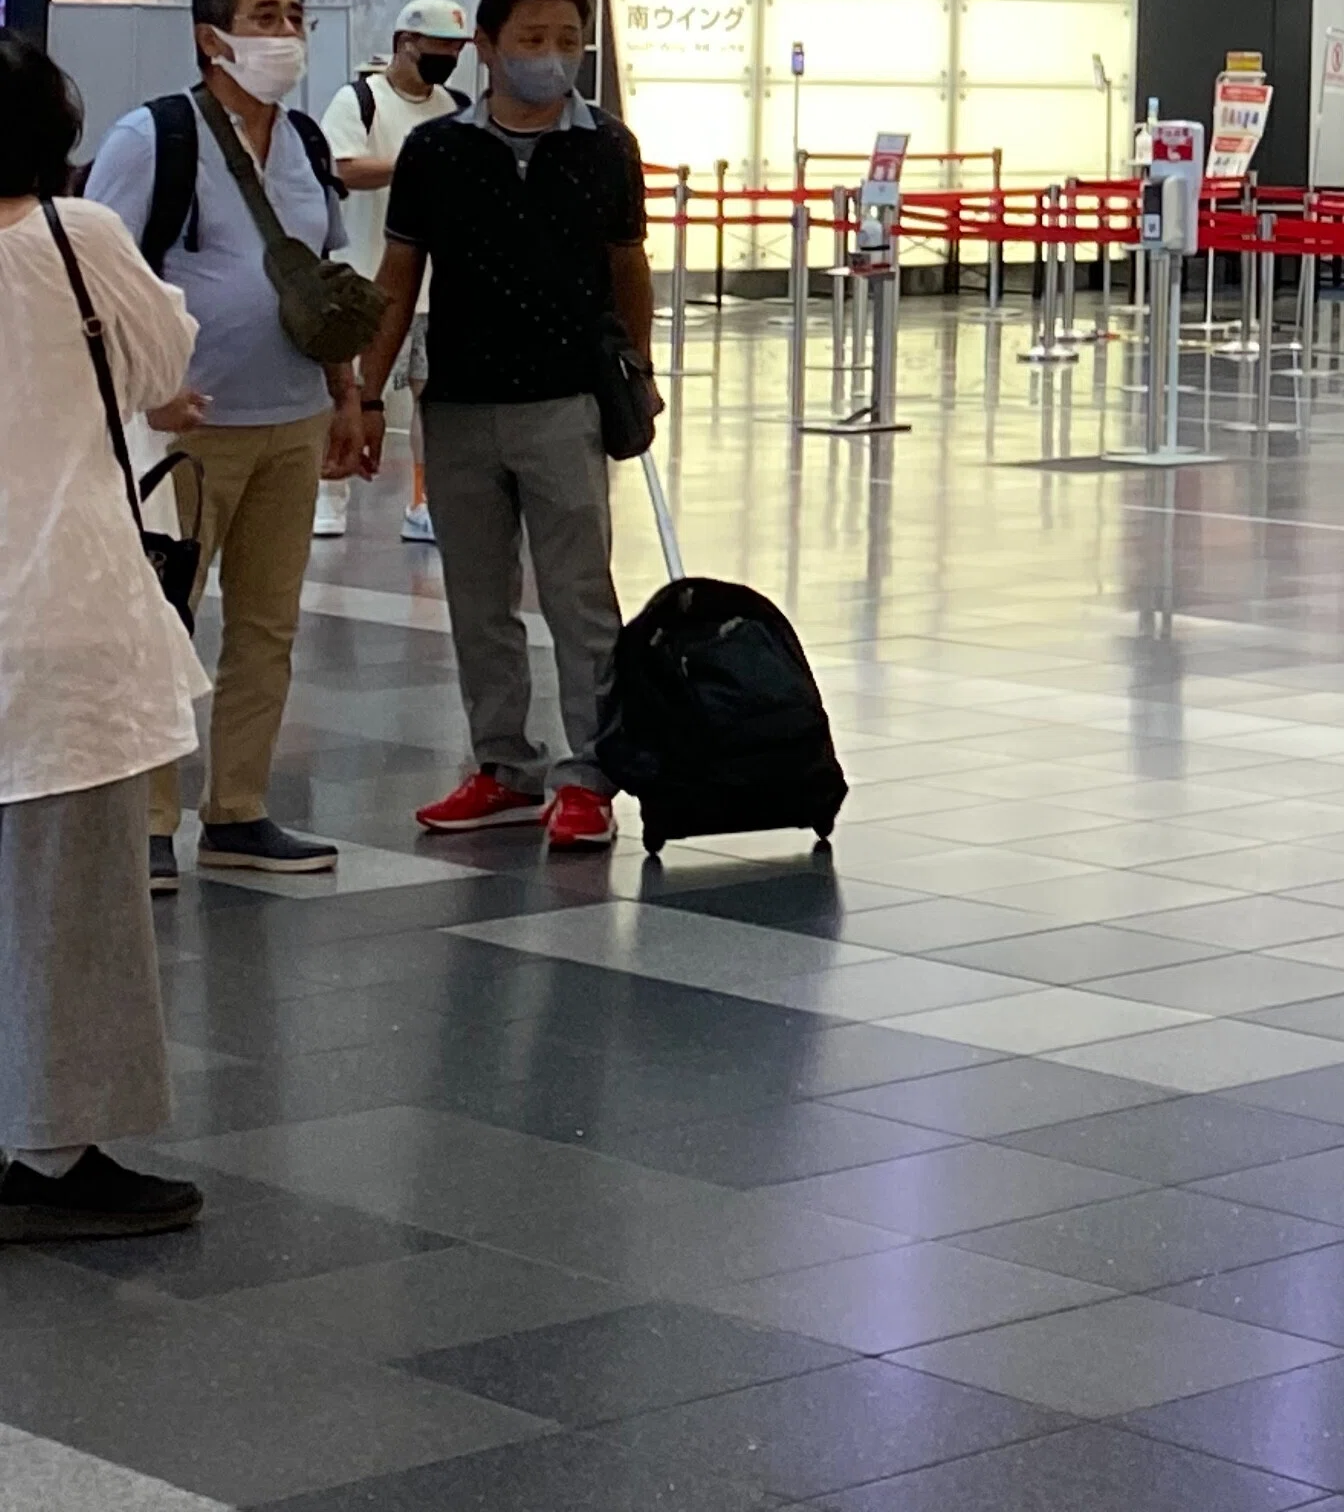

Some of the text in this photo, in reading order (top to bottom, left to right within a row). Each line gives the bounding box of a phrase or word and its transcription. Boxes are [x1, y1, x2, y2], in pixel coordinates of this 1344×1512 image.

[627, 5, 746, 33] 南ウイング
